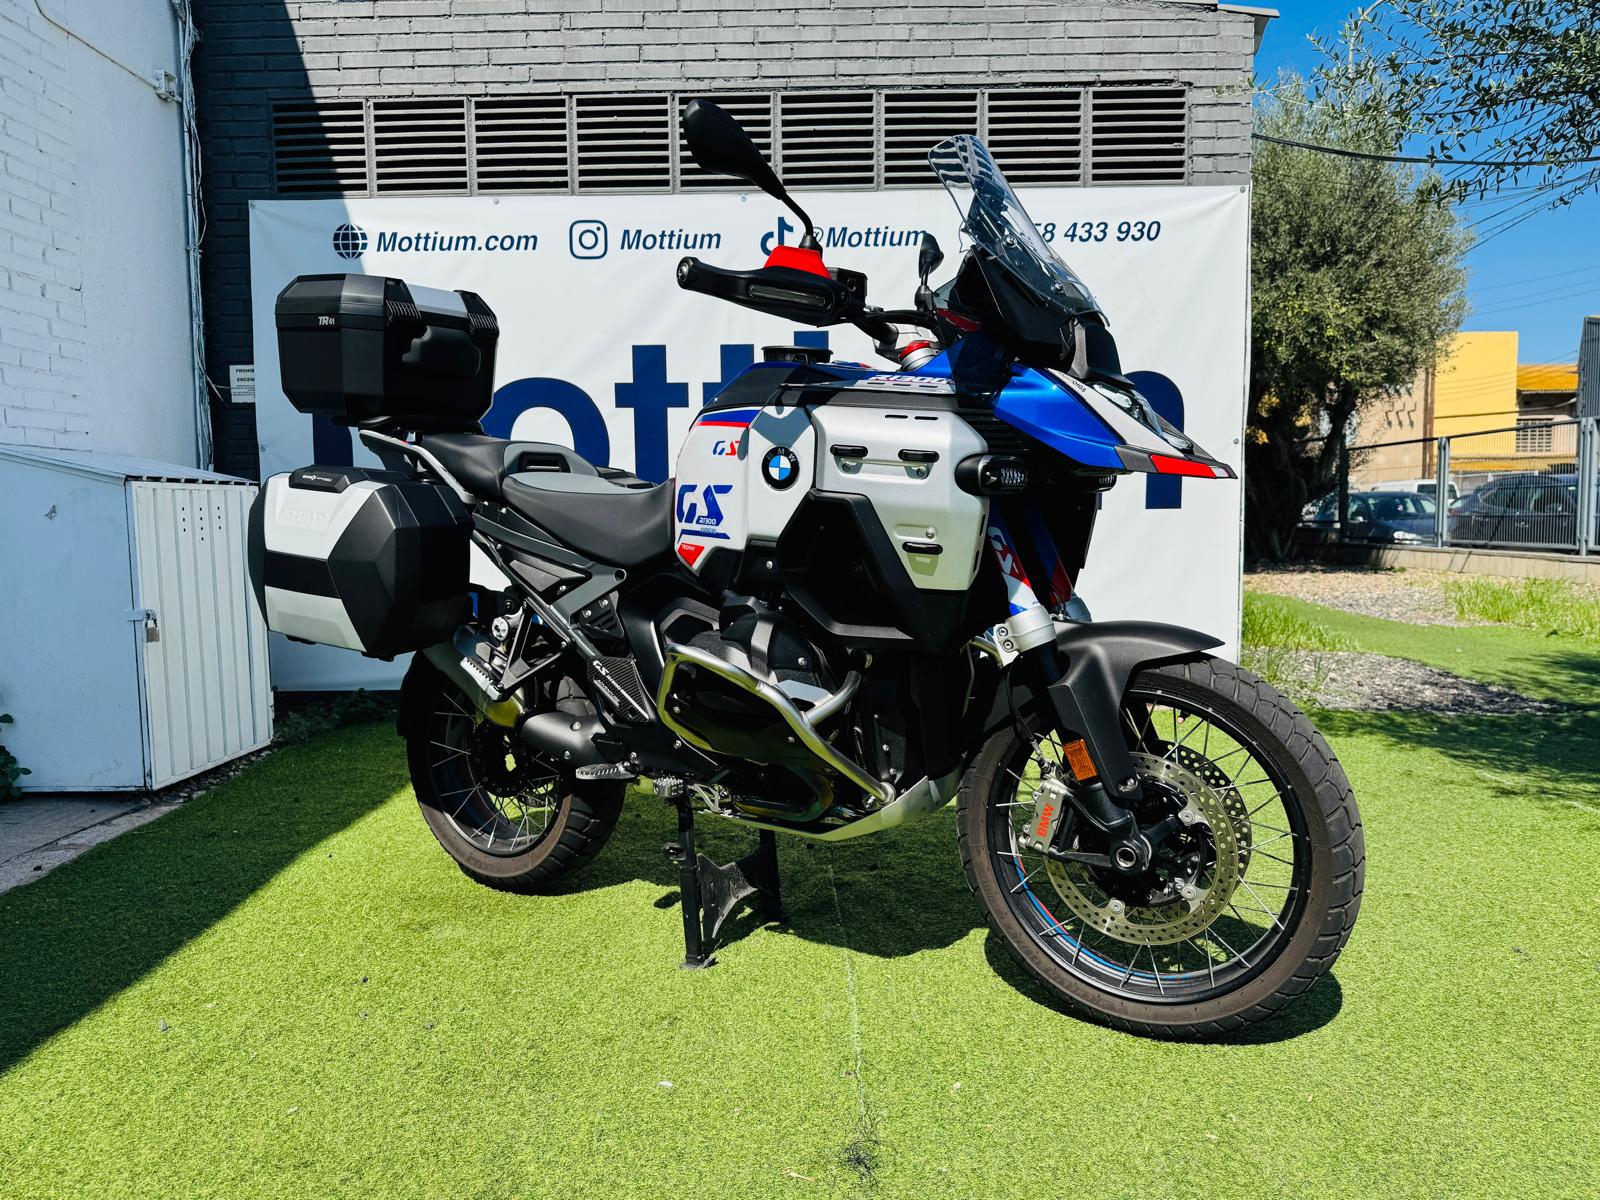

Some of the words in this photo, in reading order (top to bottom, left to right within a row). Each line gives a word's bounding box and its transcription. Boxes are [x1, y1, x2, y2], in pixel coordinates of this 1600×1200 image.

[377, 231, 538, 252] Mottium.com
[620, 229, 721, 250] Mottium
[1064, 221, 1108, 242] 433
[1116, 220, 1161, 242] 930
[712, 441, 742, 455] GS
[766, 448, 797, 462] BMW
[676, 484, 733, 526] GS
[592, 660, 610, 676] GS
[1036, 802, 1055, 838] BMW
